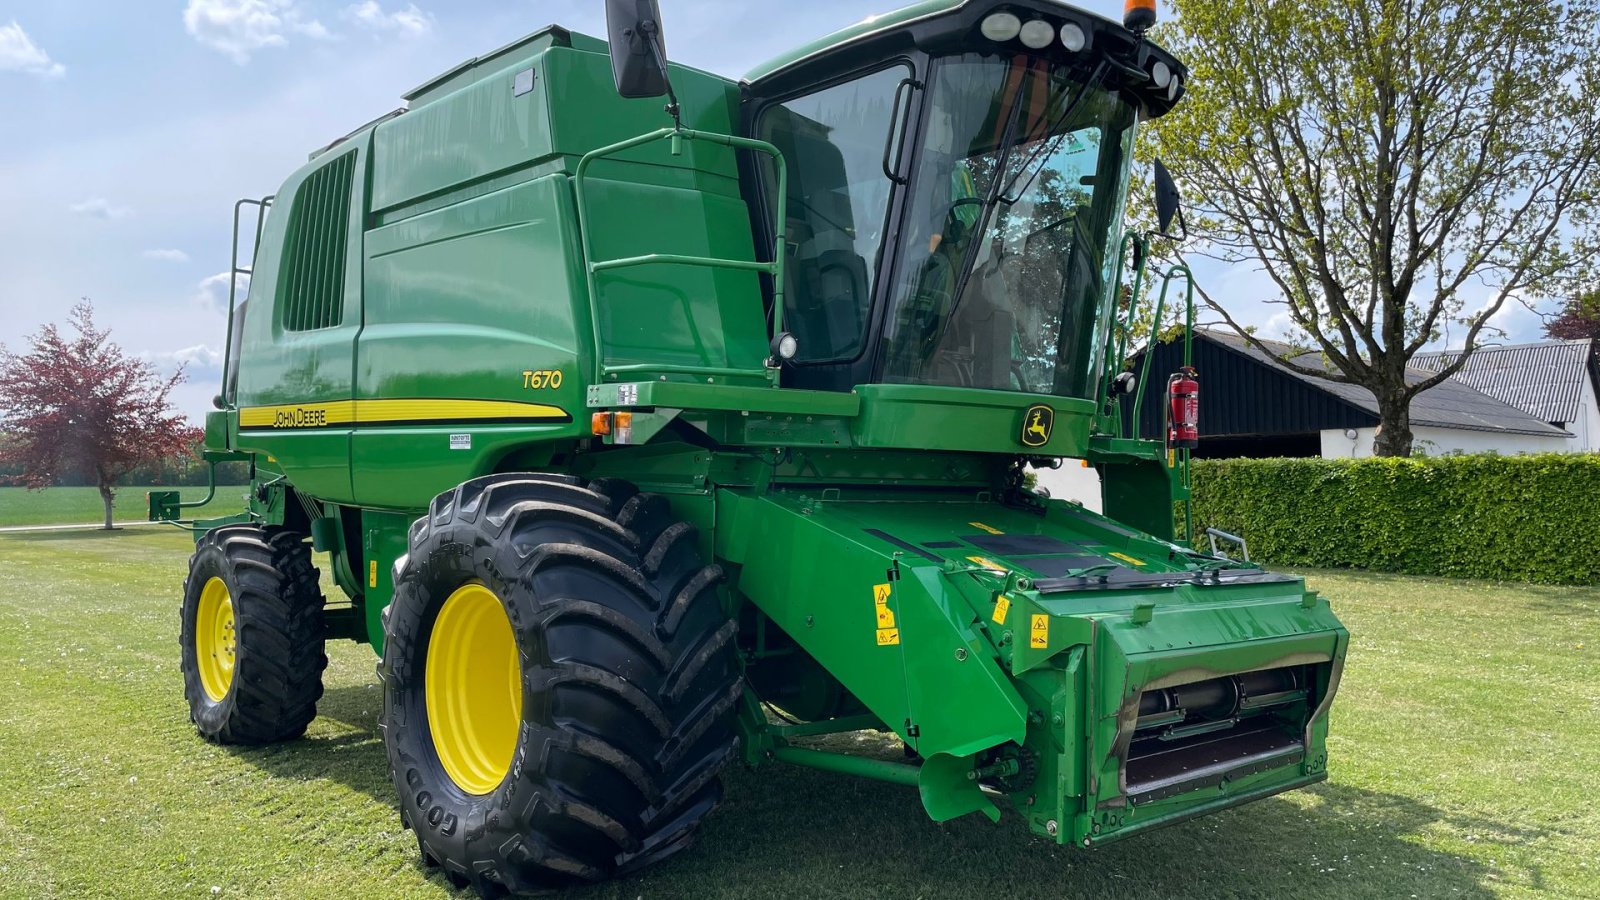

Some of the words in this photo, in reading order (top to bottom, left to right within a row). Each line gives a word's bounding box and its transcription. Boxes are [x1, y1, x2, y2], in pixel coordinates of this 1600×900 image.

[522, 370, 562, 389] T670
[273, 410, 296, 425] JOHN
[297, 408, 326, 425] DEERE
